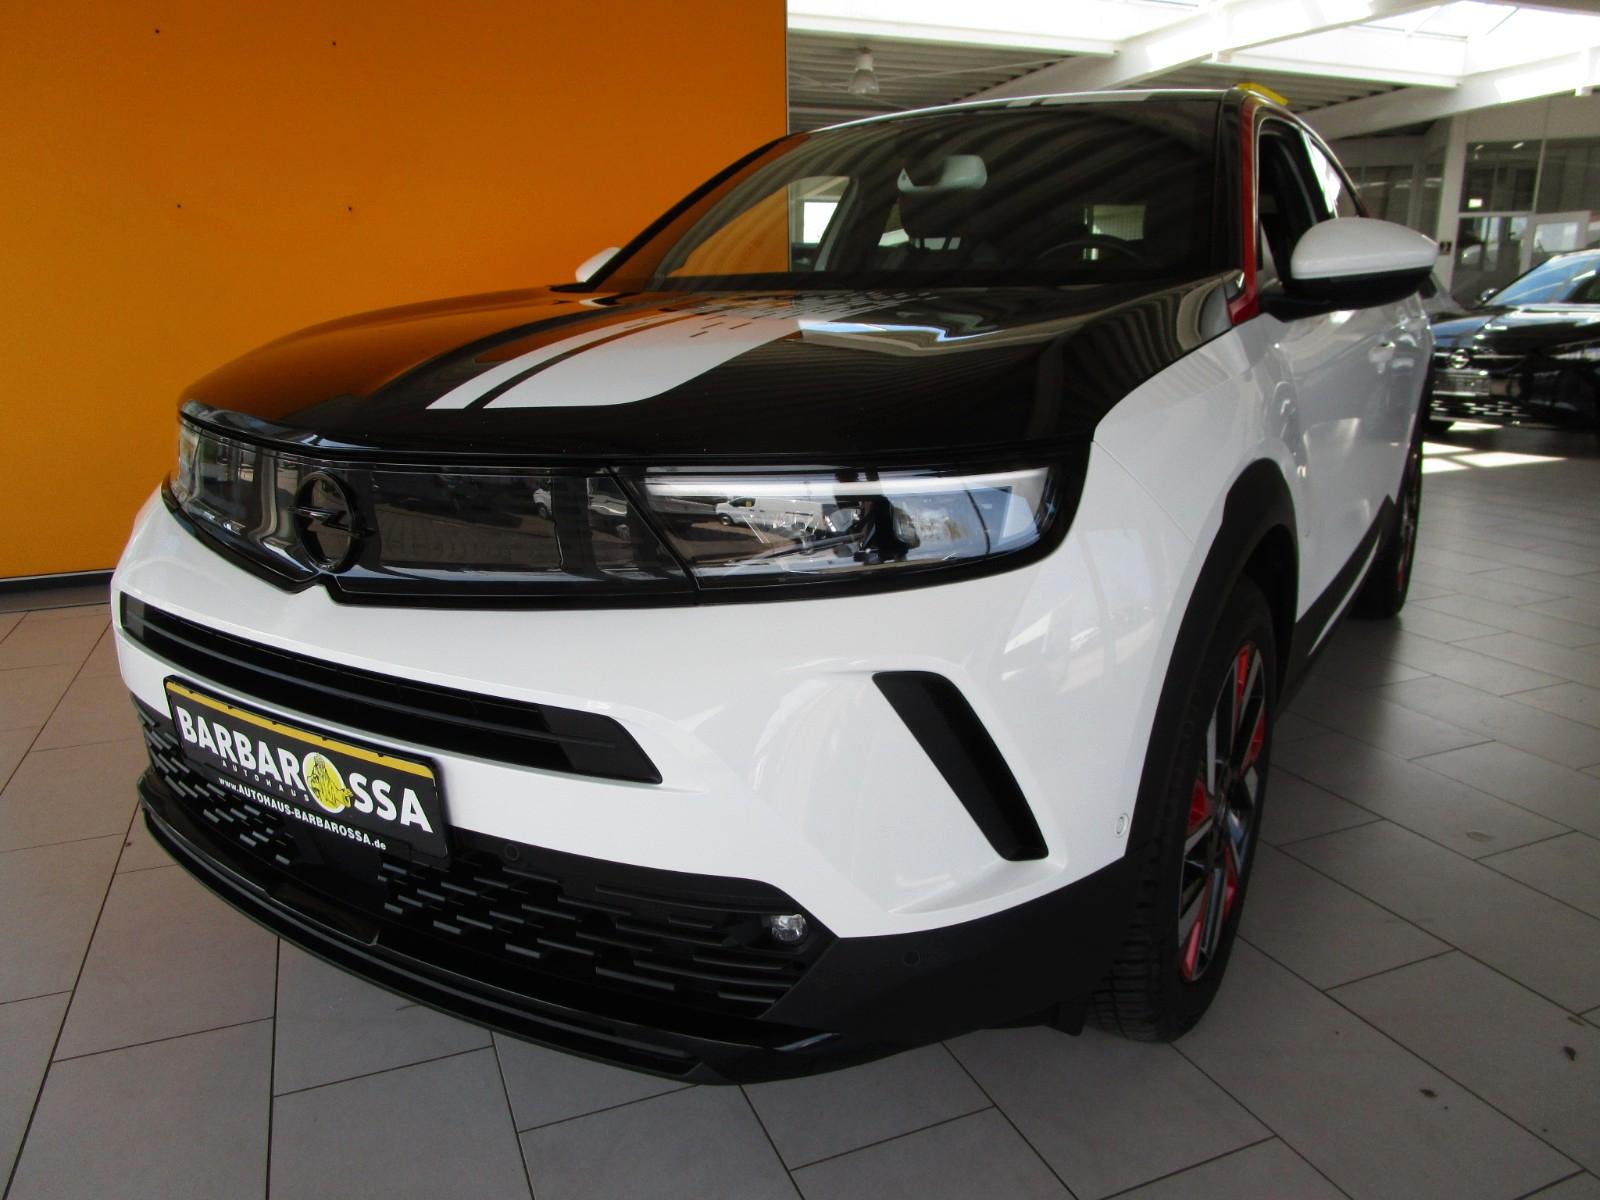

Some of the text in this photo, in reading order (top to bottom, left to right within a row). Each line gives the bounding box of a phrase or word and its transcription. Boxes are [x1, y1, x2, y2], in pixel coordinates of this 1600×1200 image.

[176, 705, 433, 833] BARBAROSSA
[222, 760, 310, 802] AUTOHAUS
[218, 777, 387, 850] www.AUTOHAUS-BARBAROSSA.de
